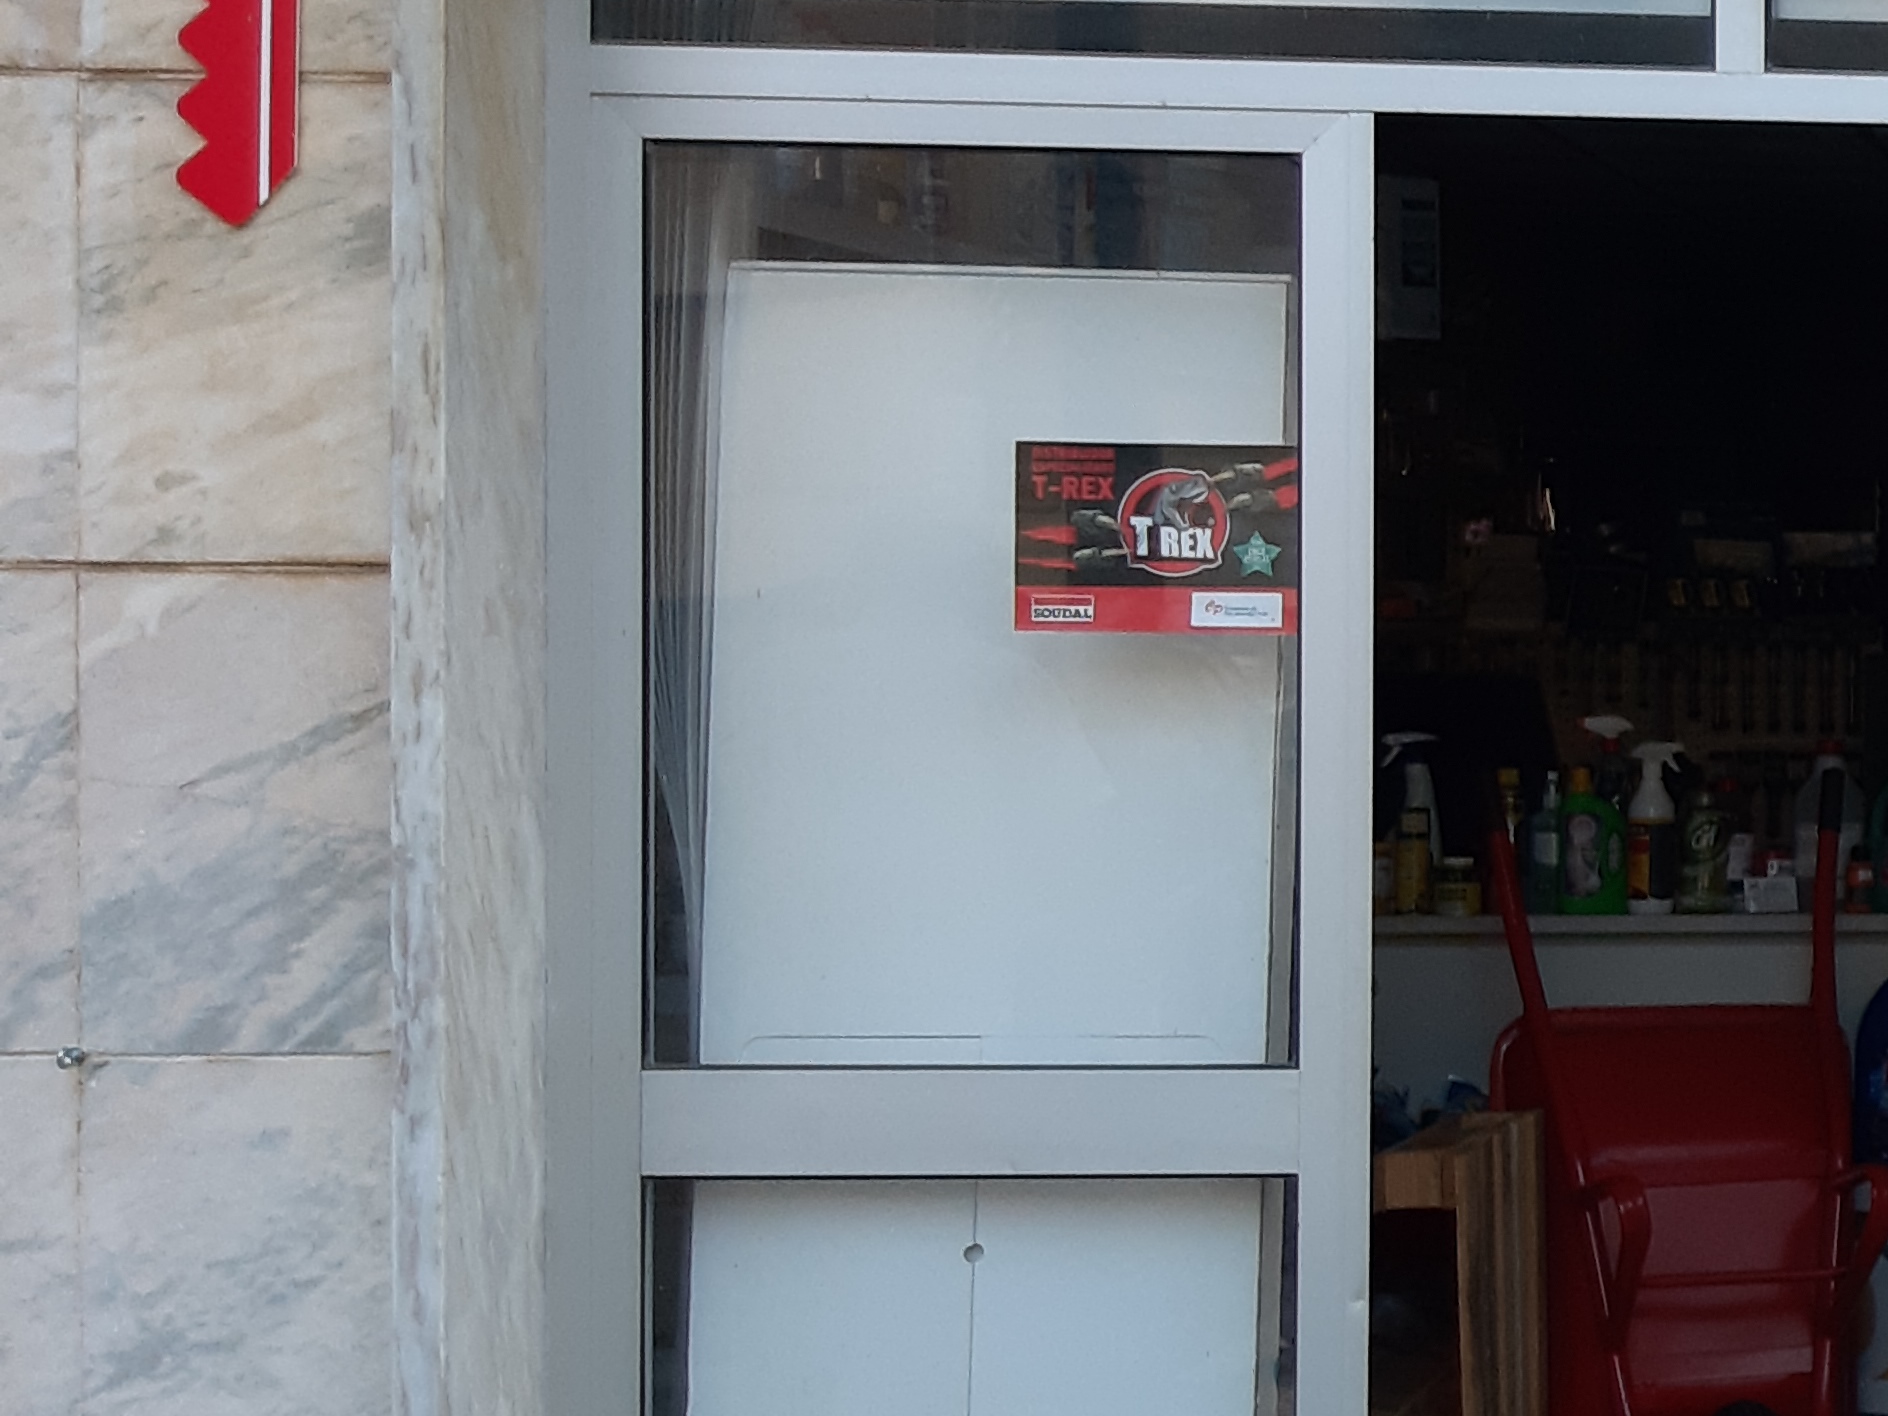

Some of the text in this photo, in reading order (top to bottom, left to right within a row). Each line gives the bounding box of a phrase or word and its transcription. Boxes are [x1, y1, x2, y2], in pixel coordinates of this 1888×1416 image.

[1031, 474, 1116, 501] T-REX
[1129, 515, 1154, 558] T
[1159, 524, 1216, 560] REX
[1033, 607, 1093, 620] SOUDAL
